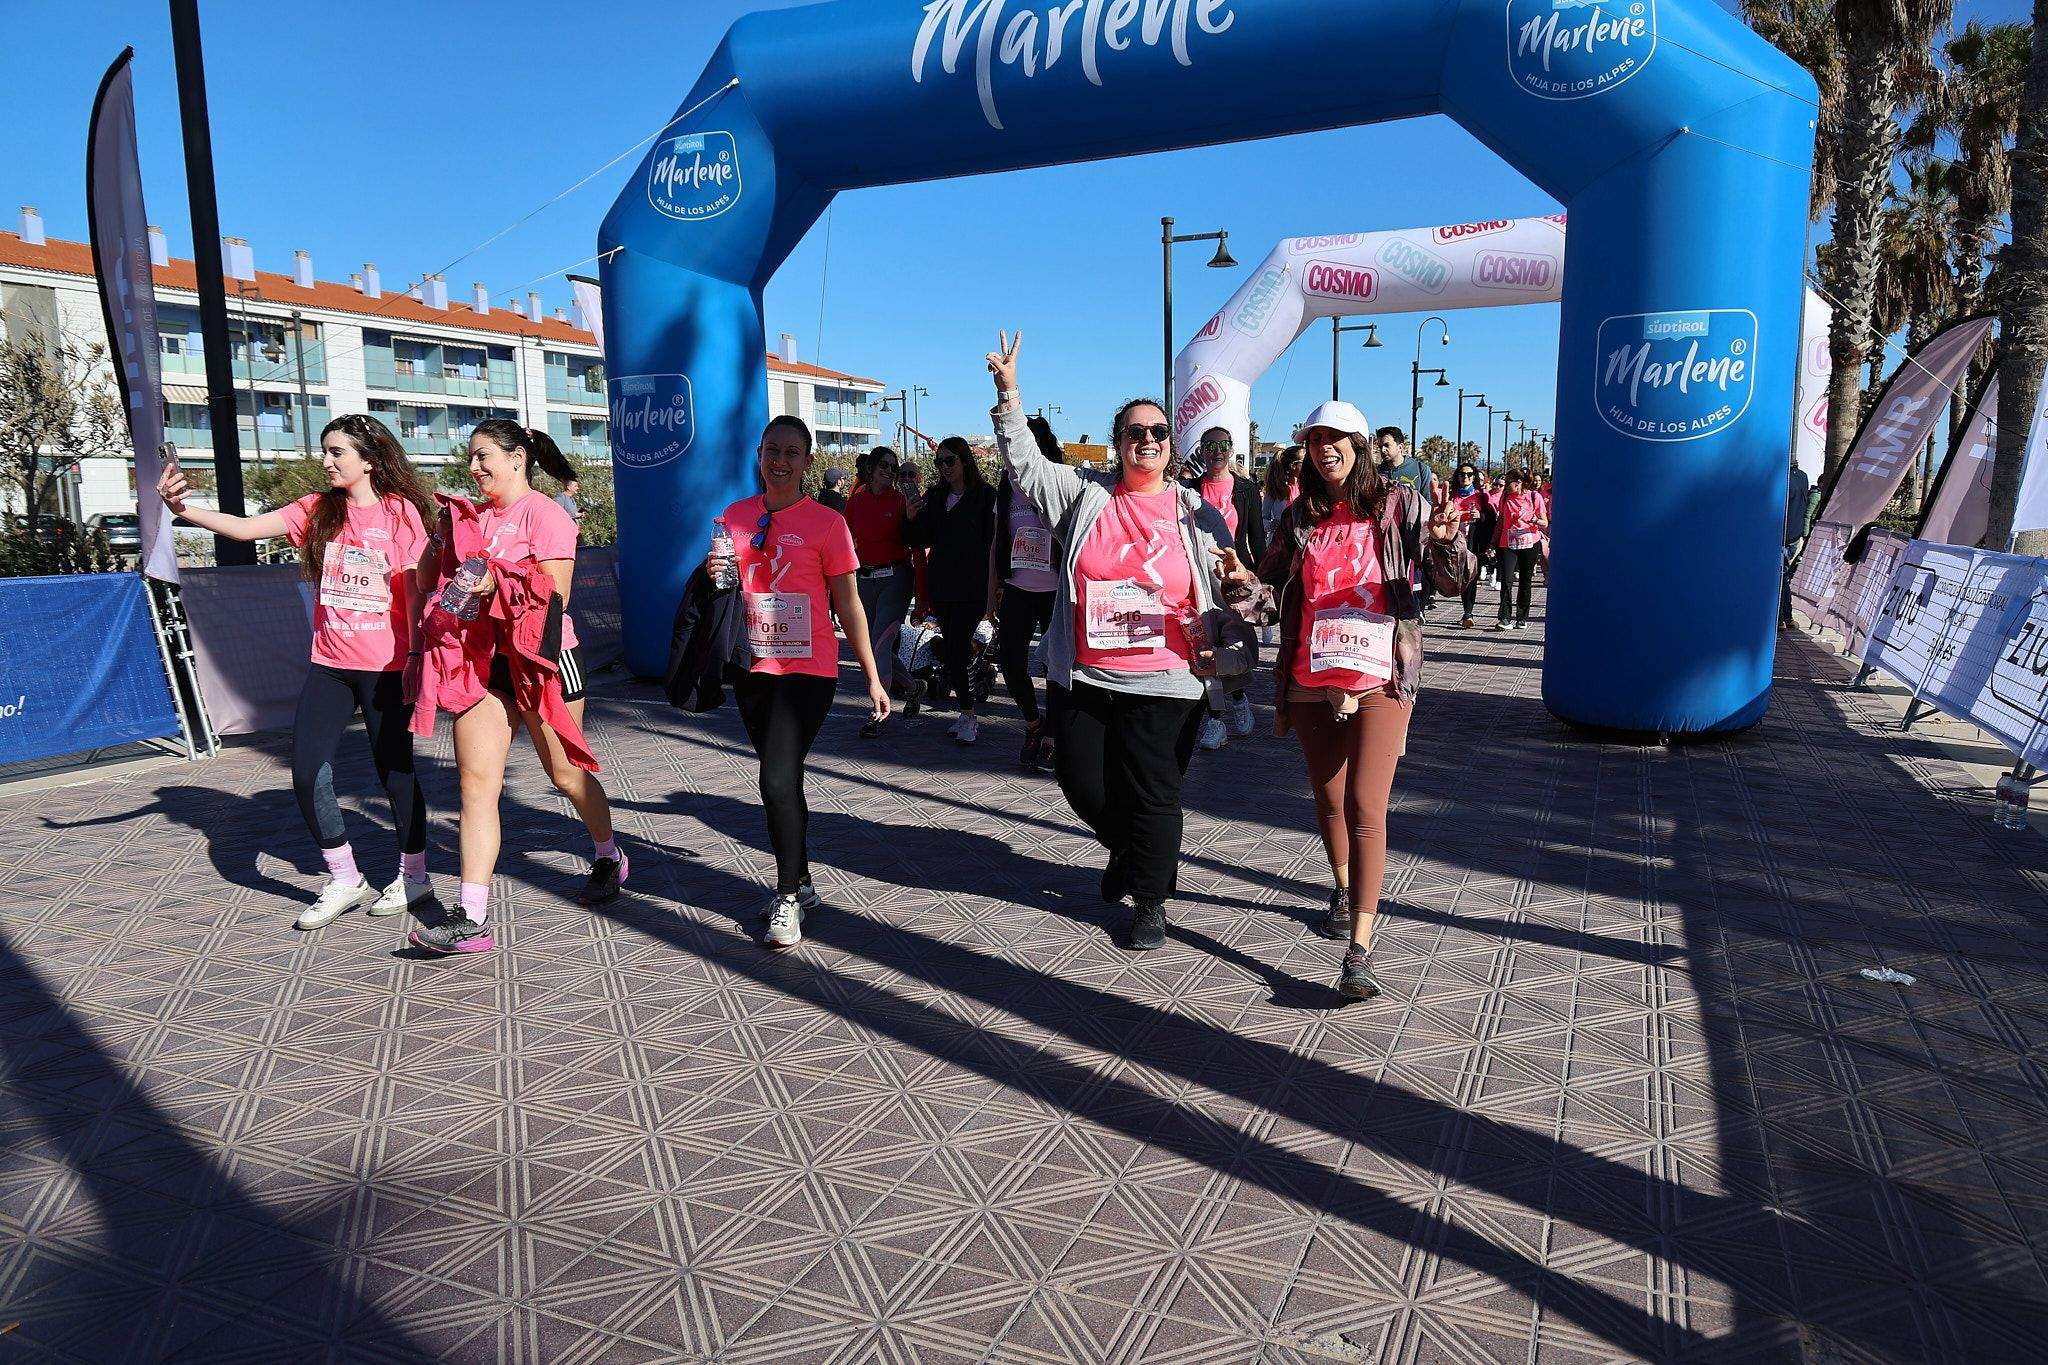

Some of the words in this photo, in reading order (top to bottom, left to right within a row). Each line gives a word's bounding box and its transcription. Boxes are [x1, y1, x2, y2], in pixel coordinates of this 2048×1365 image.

[1518, 6, 1646, 72] Marlene
[912, 0, 1235, 129] Marlene
[1525, 73, 1548, 91] HIJA
[1552, 83, 1567, 92] DE
[1571, 79, 1594, 92] LOS
[1598, 57, 1635, 85] ALPES
[654, 152, 732, 198] Marlene
[656, 197, 672, 211] HIJA
[674, 206, 685, 214] DE
[688, 206, 704, 215] LOS
[706, 194, 730, 212] ALPES
[1308, 264, 1373, 298] COSMO
[1382, 240, 1447, 288] COSMO
[1479, 255, 1550, 286] COSMO
[1238, 271, 1285, 331] COSMO
[1604, 340, 1745, 407] Marlene
[612, 395, 686, 444] Marlene
[1174, 381, 1219, 436] COSMO
[1609, 405, 1634, 426] HIJA
[1637, 420, 1656, 432] DE
[1660, 421, 1687, 433] LOS
[1691, 404, 1732, 430] ALPES
[636, 453, 652, 462] LOS
[654, 441, 680, 459] ALPES
[1856, 395, 1930, 478] IMR
[341, 573, 370, 587] 016
[761, 622, 789, 633] 016
[1113, 610, 1142, 622] 016
[1339, 633, 1370, 648] 016
[0, 695, 25, 718] o!
